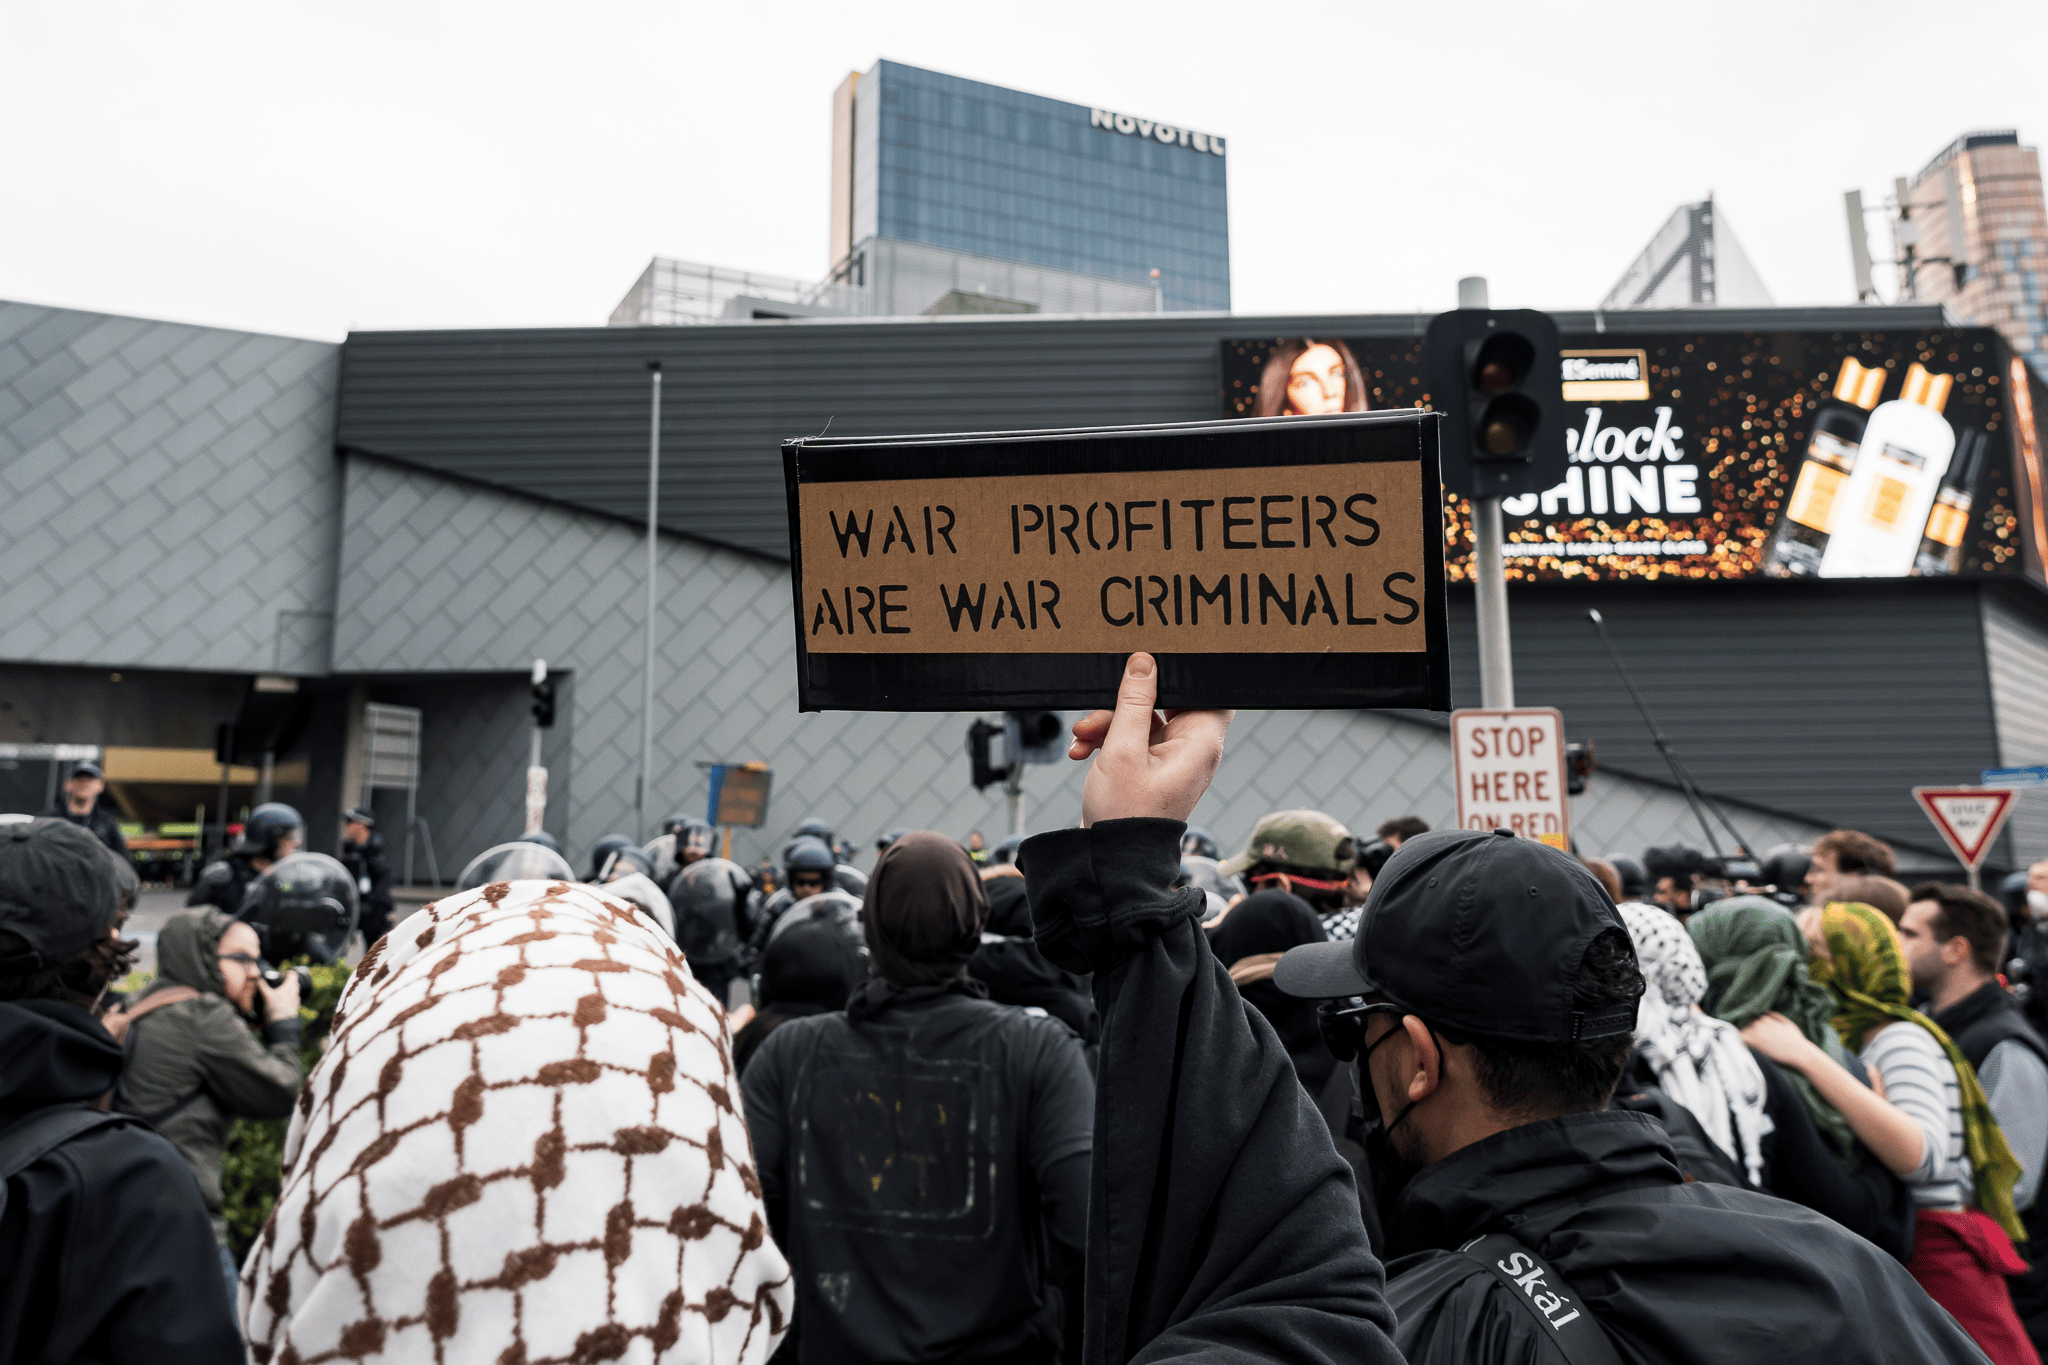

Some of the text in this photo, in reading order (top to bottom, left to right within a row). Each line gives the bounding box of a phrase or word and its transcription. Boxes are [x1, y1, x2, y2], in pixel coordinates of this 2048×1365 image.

[1090, 108, 1225, 156] NOVOTEL
[828, 492, 1380, 559] WAR PROFITEERS
[812, 571, 1420, 636] ARE WAR CRIMINALS
[1470, 726, 1545, 759] STOP
[1470, 770, 1551, 803] HERE
[1468, 812, 1559, 839] ON RED
[1497, 1252, 1580, 1331] Skál
